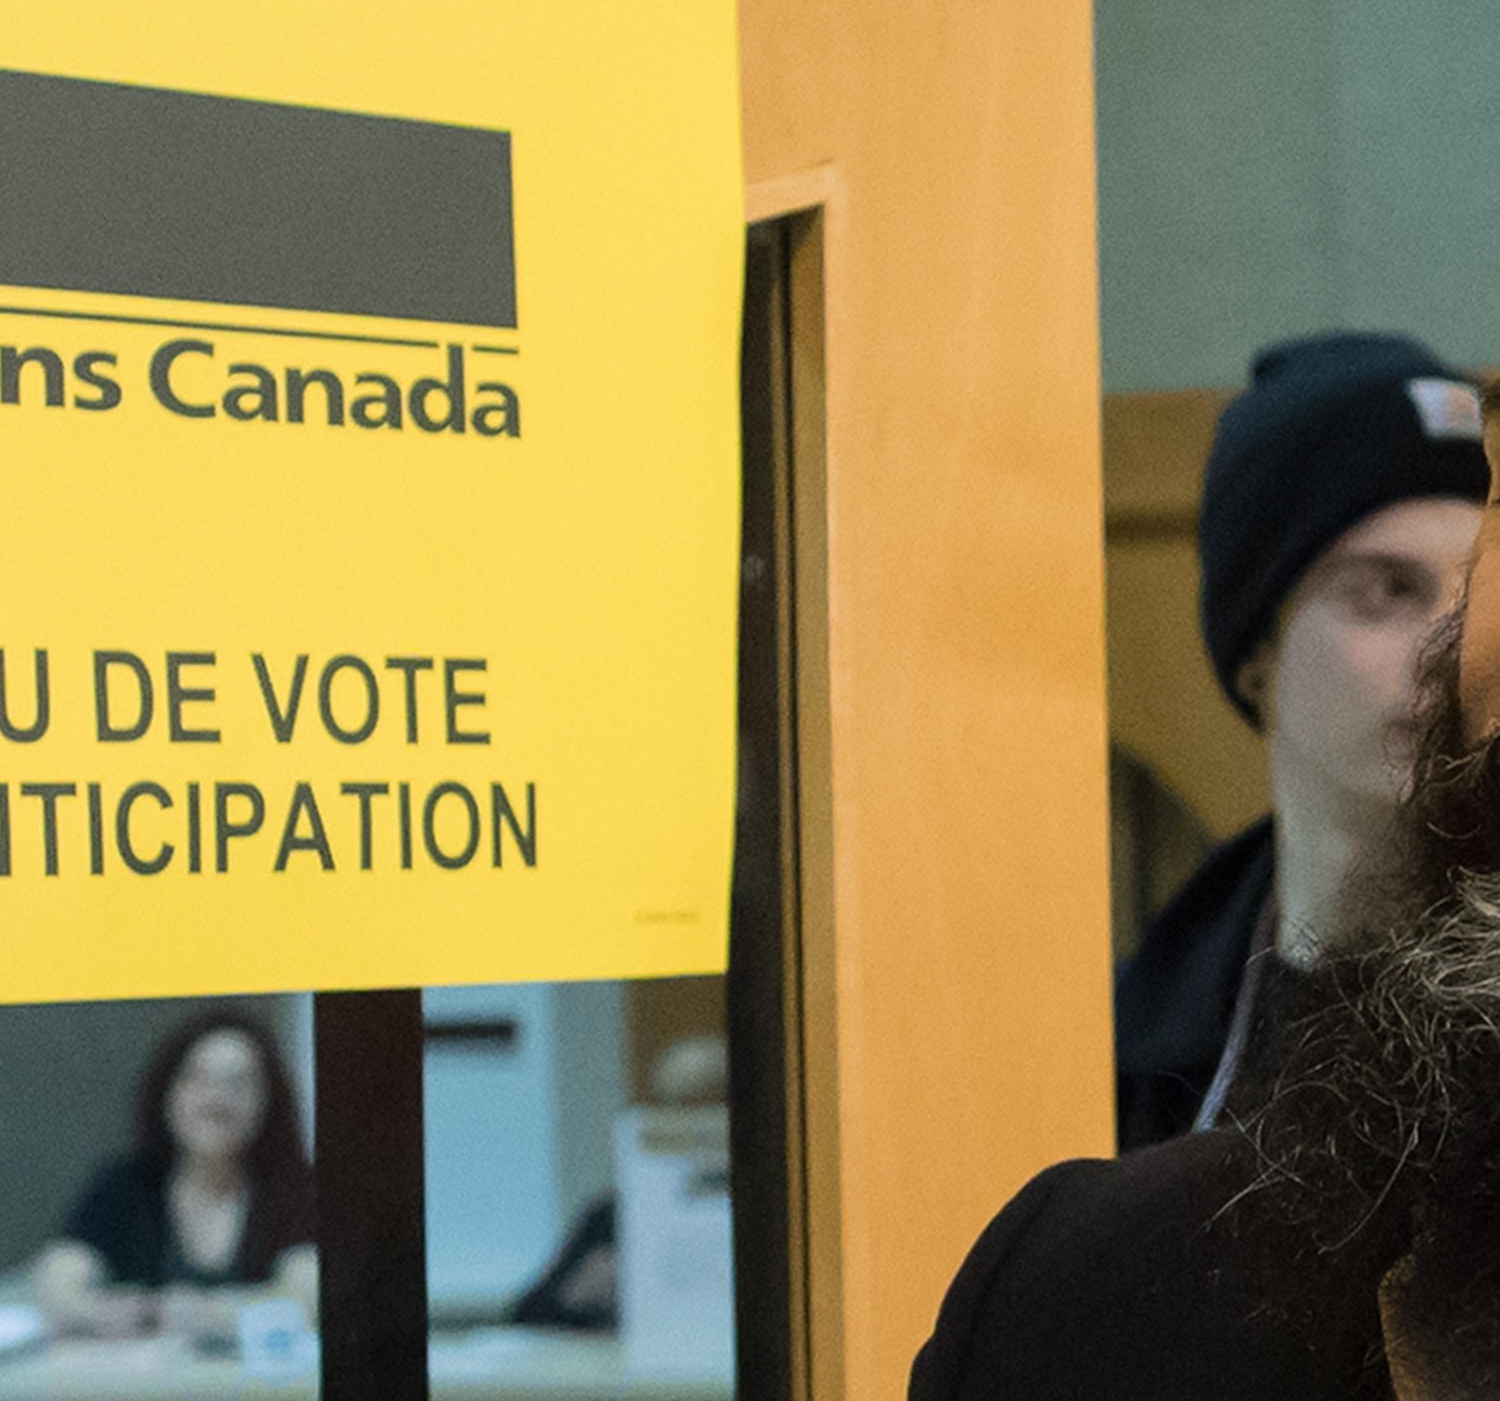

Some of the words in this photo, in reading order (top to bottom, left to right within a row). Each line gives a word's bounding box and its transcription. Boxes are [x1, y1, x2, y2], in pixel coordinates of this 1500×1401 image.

[149, 339, 521, 439] Canada
[93, 650, 222, 744] DE
[252, 653, 491, 745] VOTE
